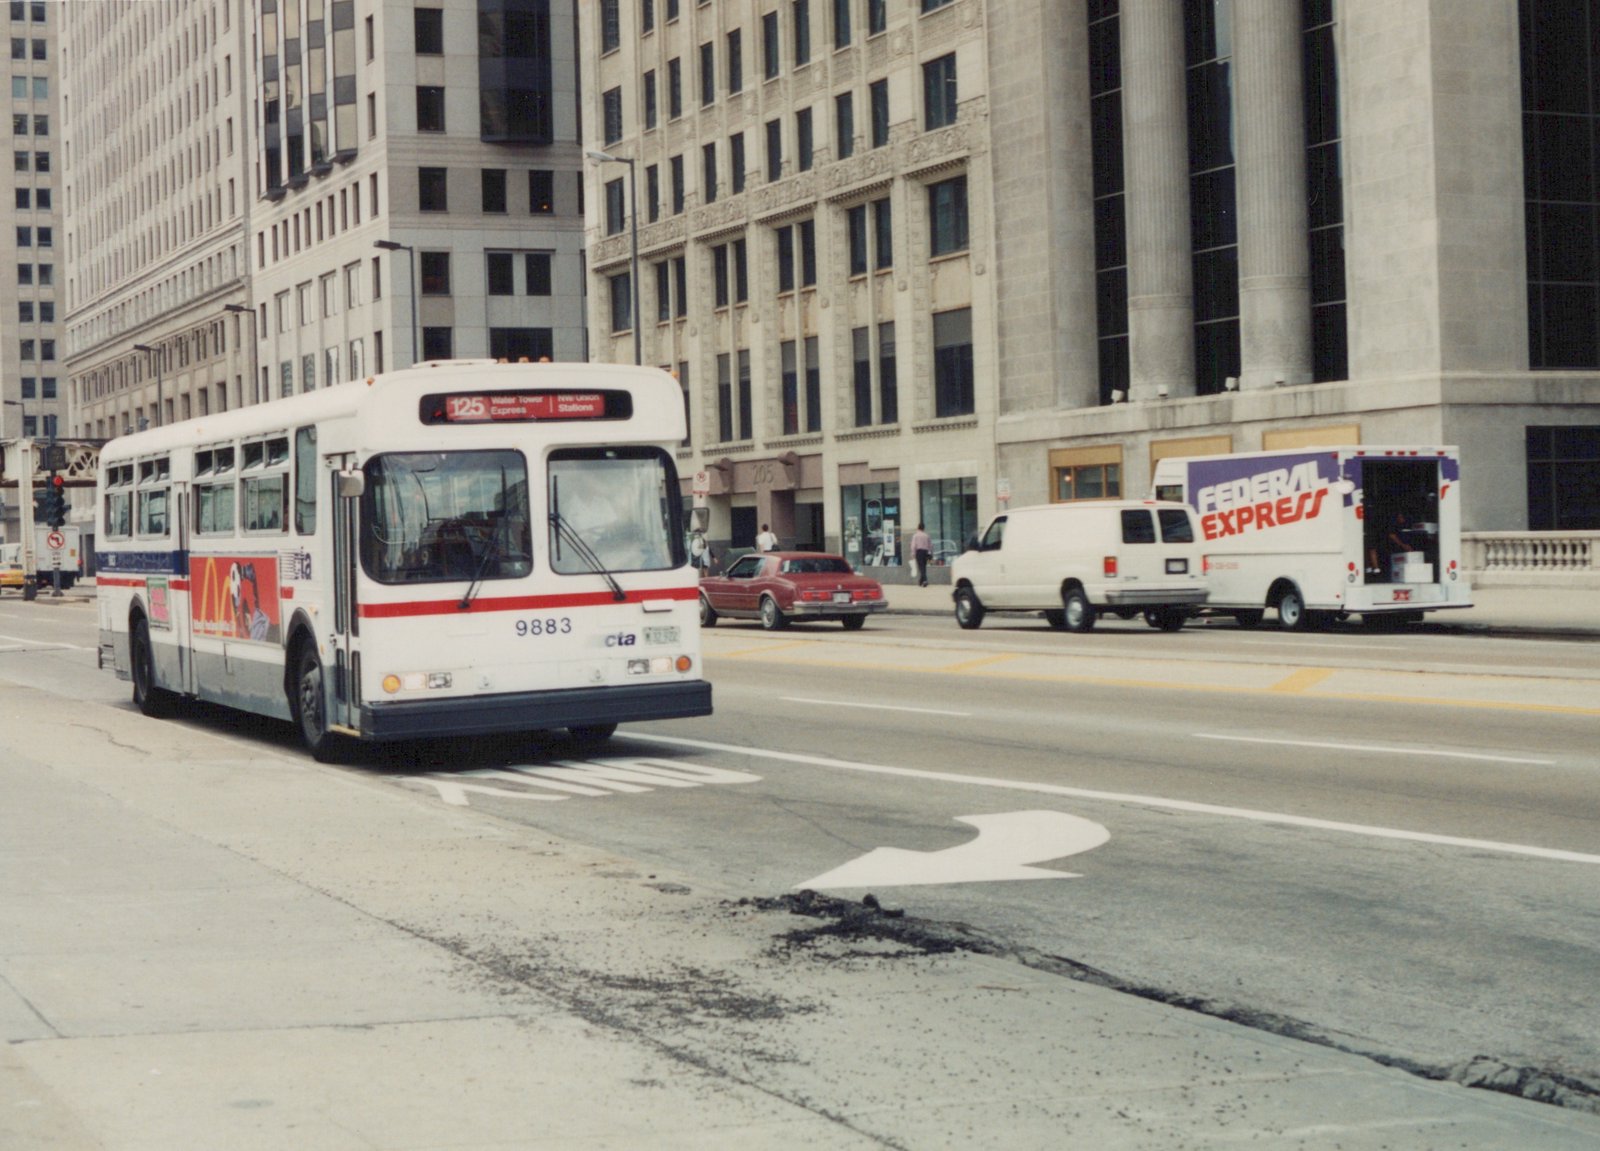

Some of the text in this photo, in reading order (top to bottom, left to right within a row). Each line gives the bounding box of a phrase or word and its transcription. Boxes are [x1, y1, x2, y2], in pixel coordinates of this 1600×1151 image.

[451, 397, 485, 416] 125
[491, 406, 526, 415] Express
[558, 403, 594, 412] Stations
[752, 463, 775, 486] 205
[1197, 460, 1329, 514] FEDERAL
[1201, 487, 1328, 541] EXPRESS
[515, 617, 572, 637] 9883
[604, 632, 636, 648] cta
